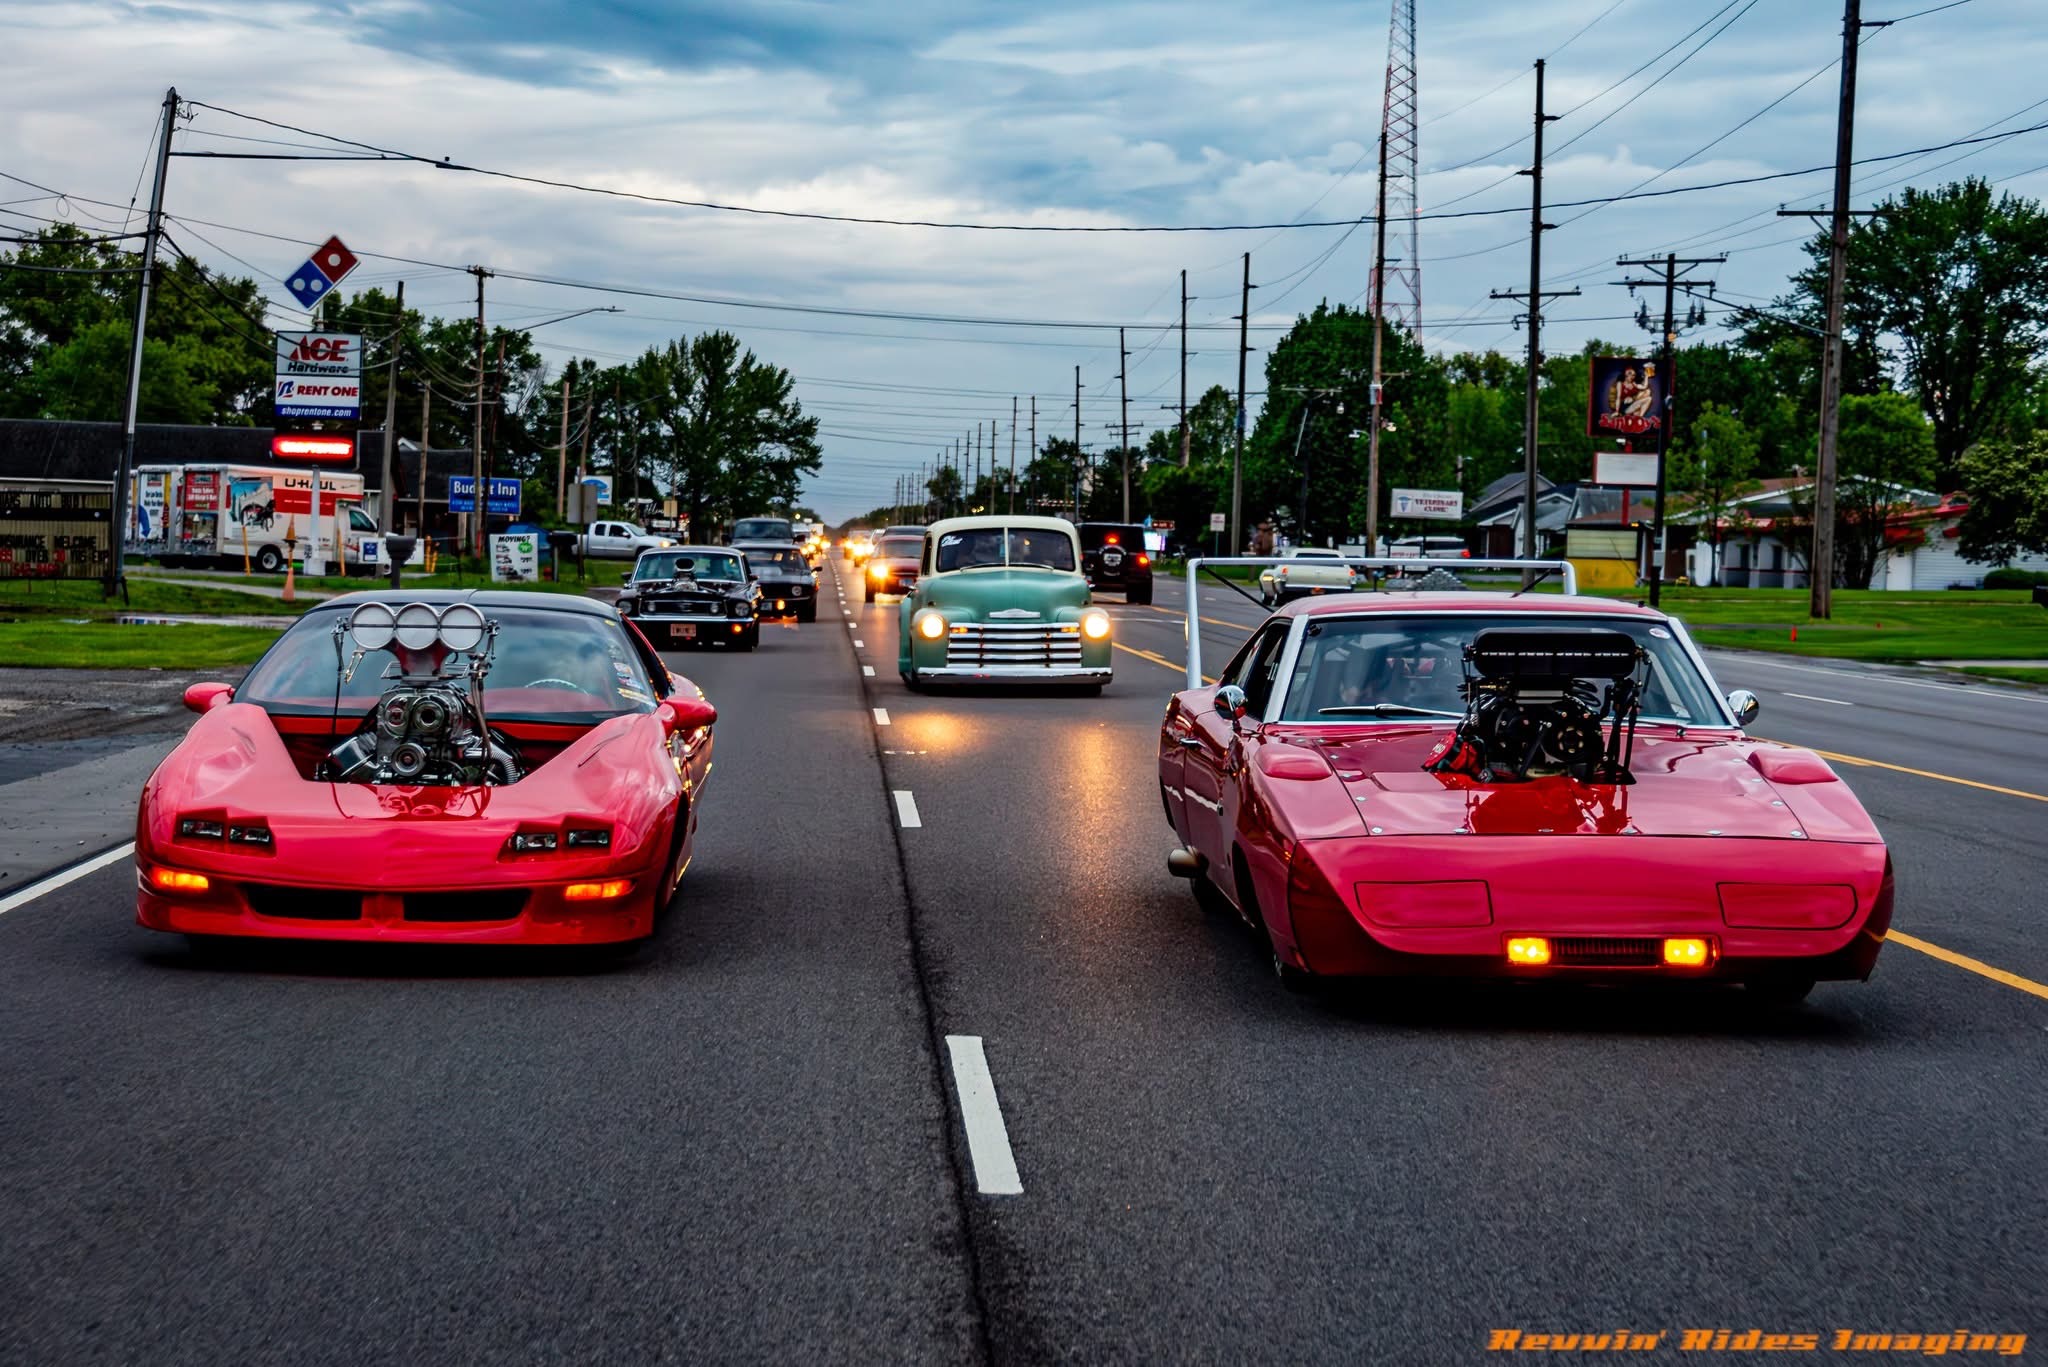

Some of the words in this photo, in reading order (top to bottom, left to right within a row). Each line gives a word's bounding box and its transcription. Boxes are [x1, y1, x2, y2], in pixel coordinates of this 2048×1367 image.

[289, 335, 349, 361] ACE
[287, 362, 350, 373] Hardware
[297, 385, 330, 396] RENT
[331, 386, 358, 397] ONE
[281, 406, 352, 417] shoprentone.com
[454, 481, 495, 497] Budt
[498, 482, 517, 496] Inn
[498, 535, 531, 543] MOVING?
